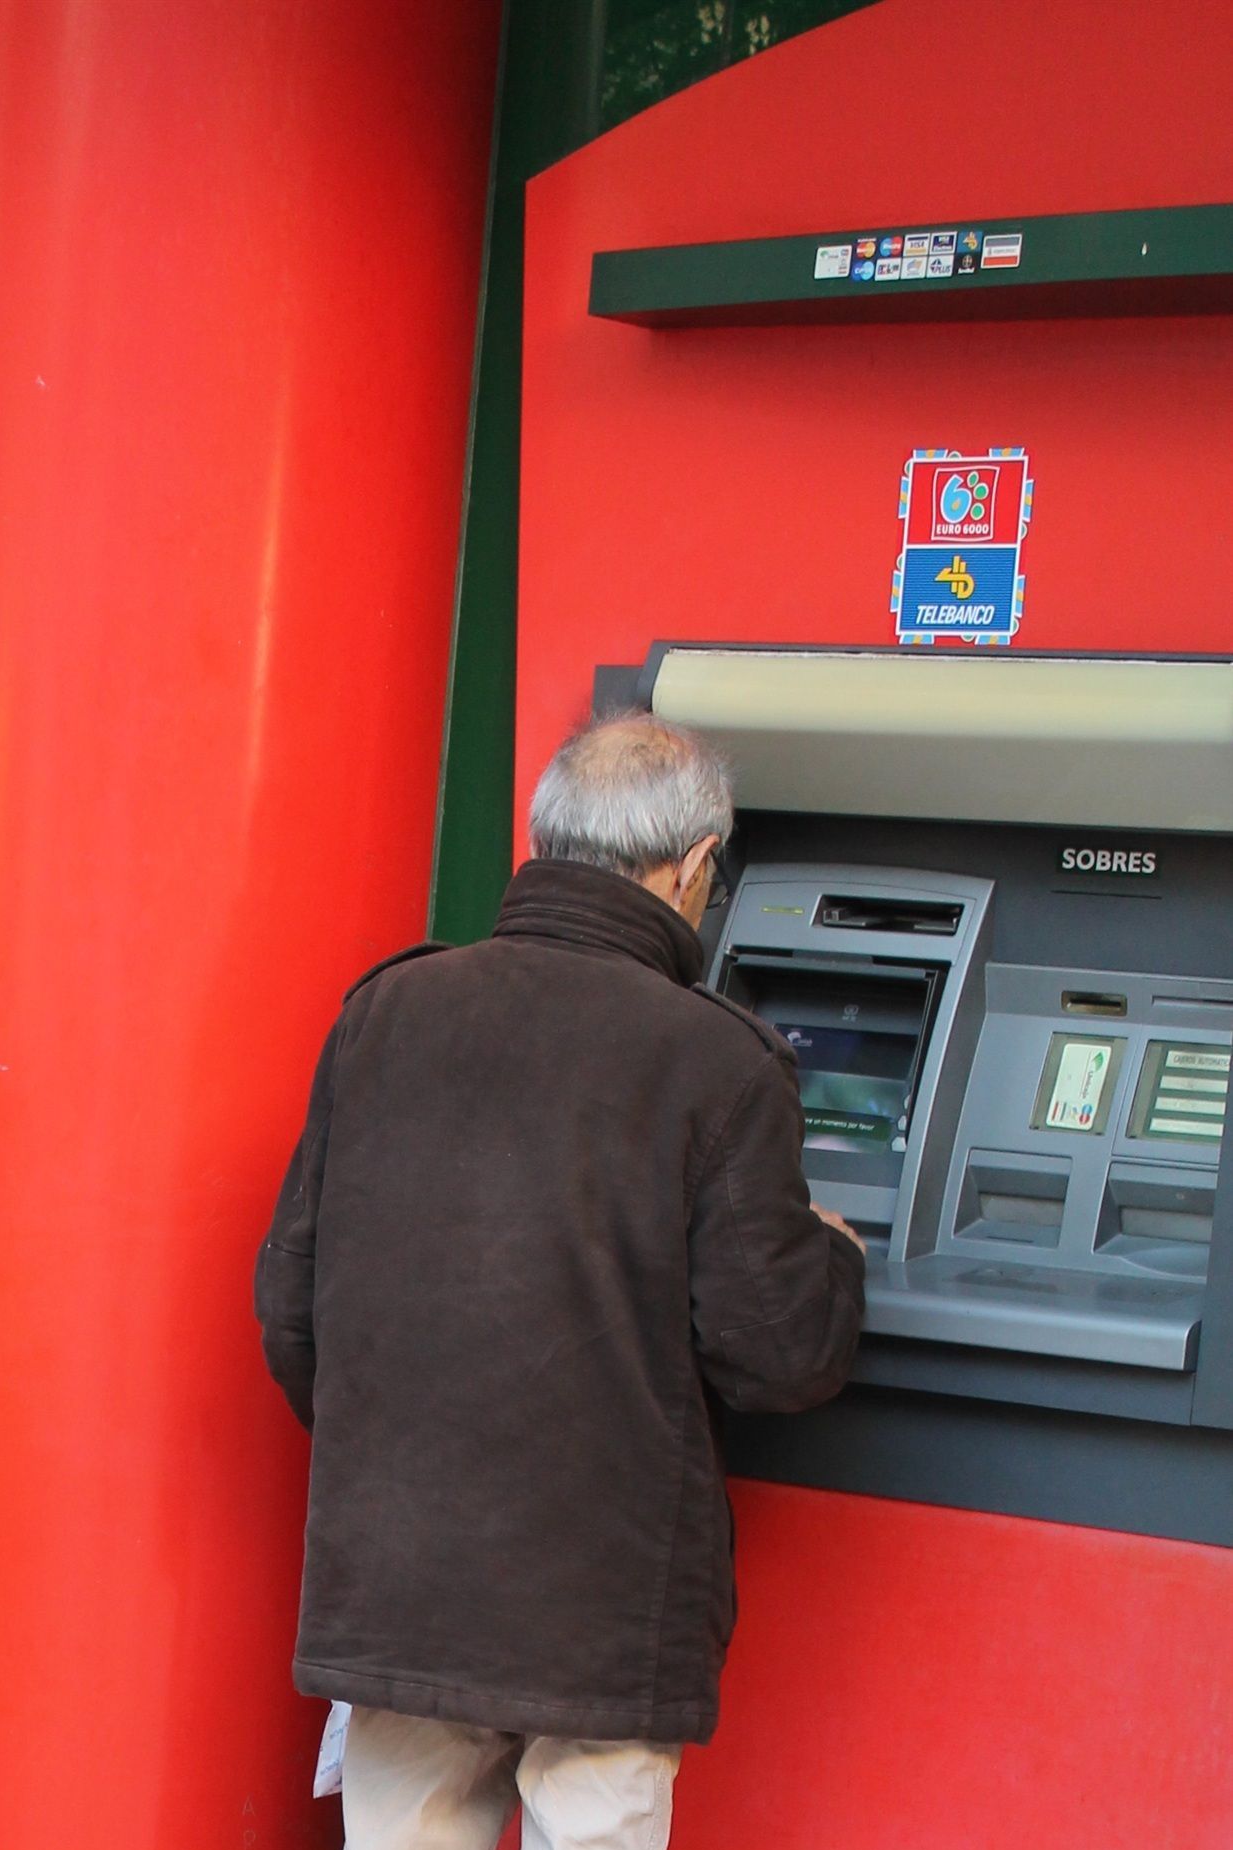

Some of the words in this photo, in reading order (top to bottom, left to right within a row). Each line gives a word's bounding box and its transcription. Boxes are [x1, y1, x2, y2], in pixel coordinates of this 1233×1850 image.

[935, 523, 961, 535] EURO
[962, 523, 990, 535] 6000
[915, 604, 996, 625] TELEBANCO
[1061, 847, 1157, 874] SOBRES
